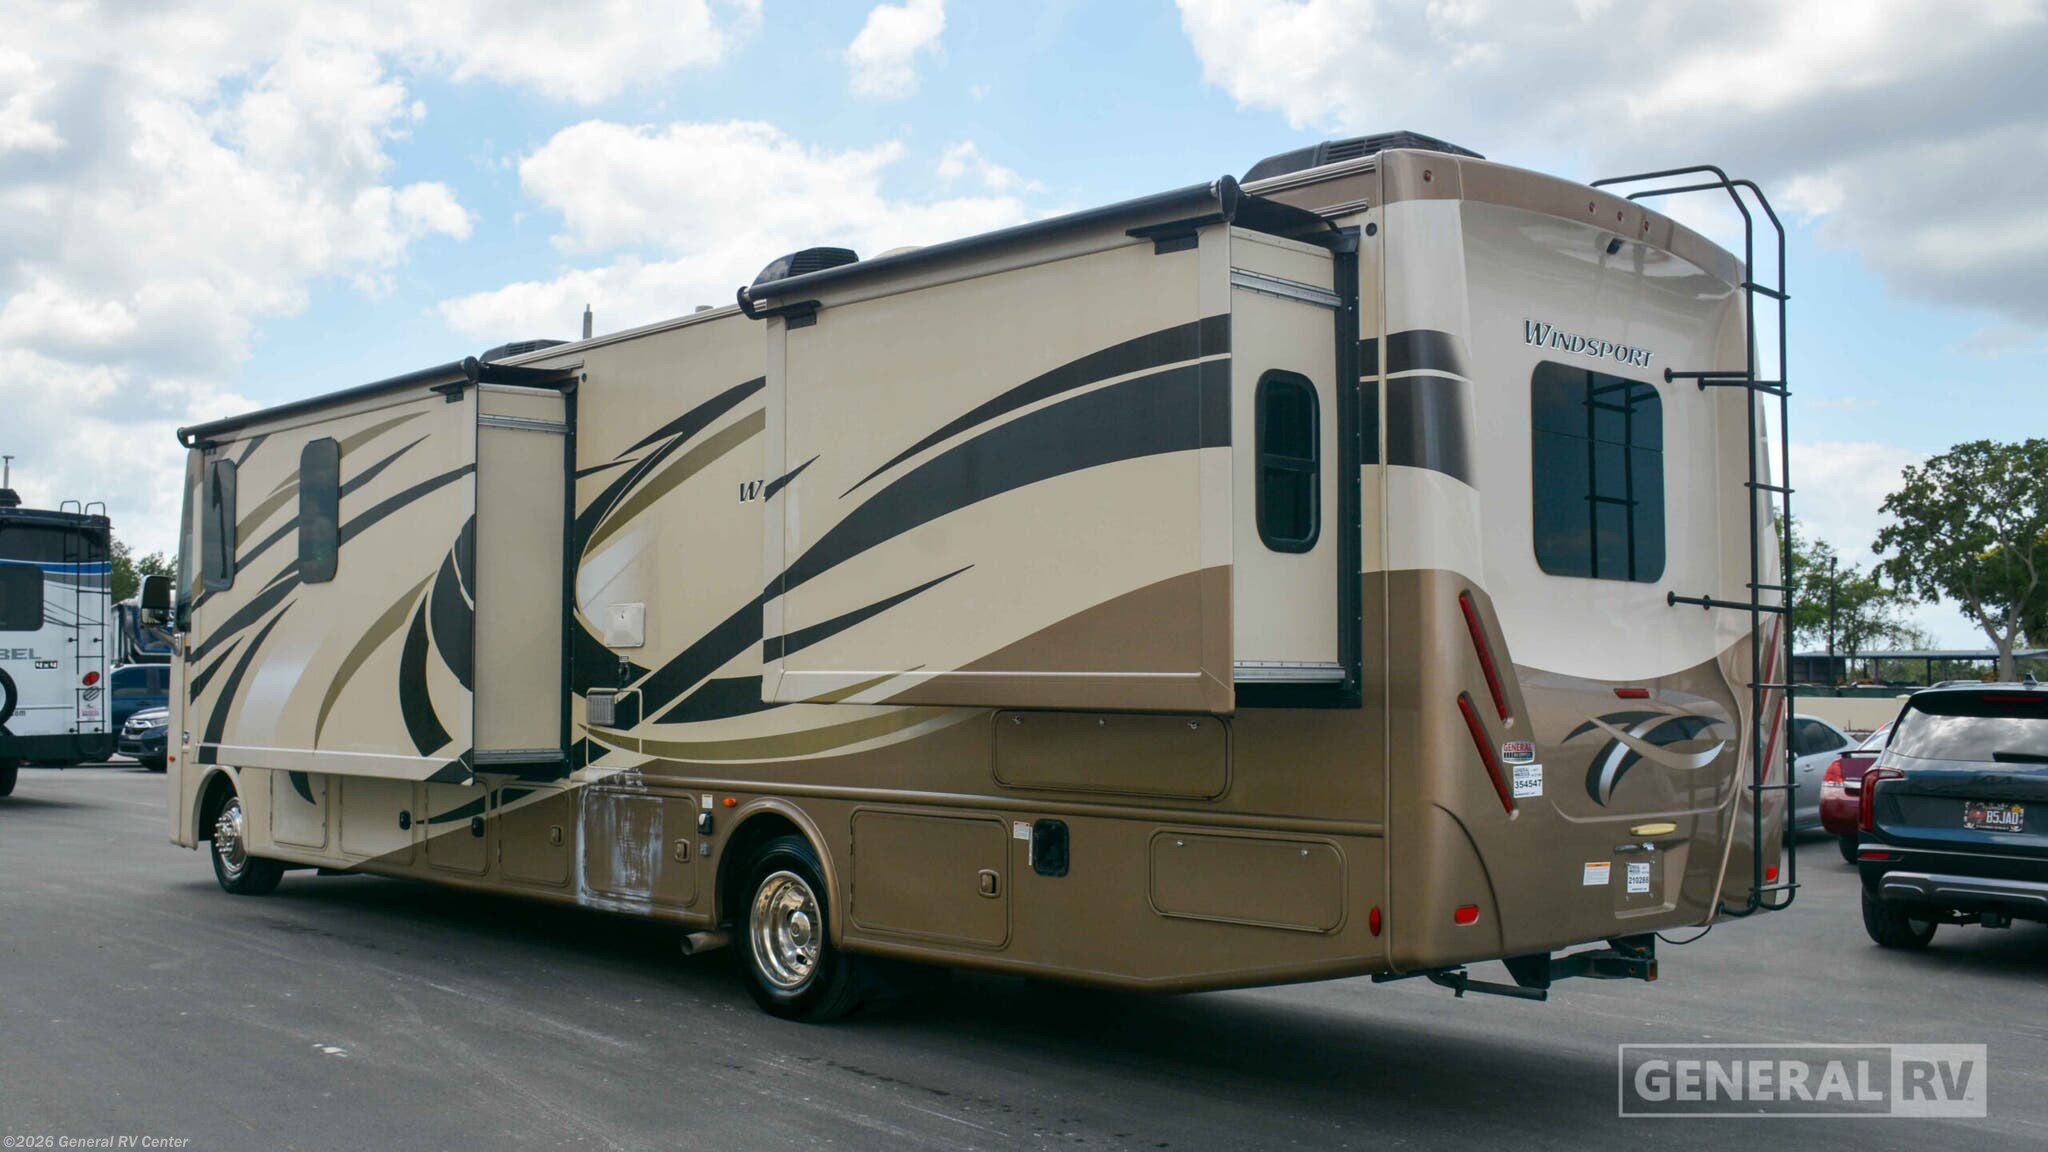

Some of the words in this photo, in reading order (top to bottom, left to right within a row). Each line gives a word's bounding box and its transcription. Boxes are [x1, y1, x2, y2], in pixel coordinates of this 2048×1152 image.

[1523, 319, 1654, 369] WINDSPORT
[1503, 743, 1533, 752] GENERAL
[1514, 779, 1542, 789] 354547
